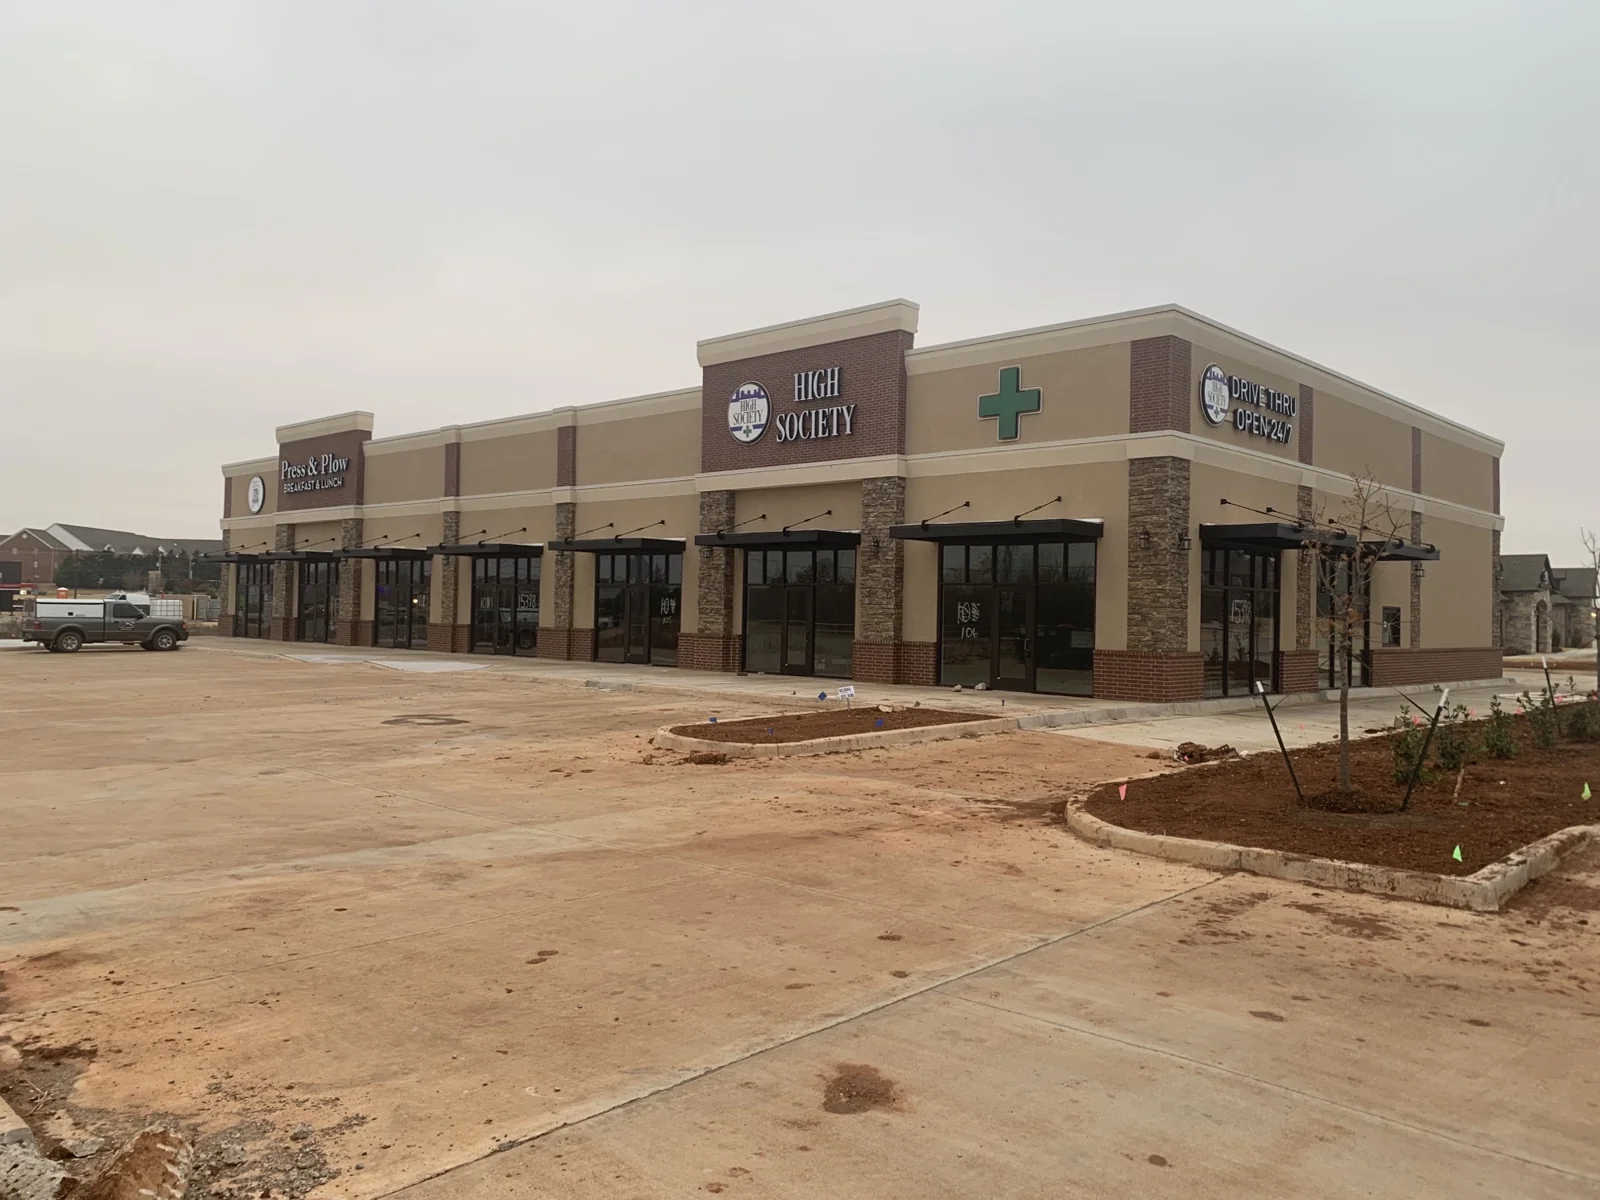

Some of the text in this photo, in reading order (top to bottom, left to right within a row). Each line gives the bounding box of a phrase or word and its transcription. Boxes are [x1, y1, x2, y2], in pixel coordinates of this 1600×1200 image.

[793, 367, 840, 402] HIGH
[1231, 376, 1297, 417] DRIVE THRU
[733, 410, 763, 425] SOCIETY
[740, 398, 757, 411] HIGH
[776, 404, 857, 443] SOCIETY
[1236, 408, 1293, 444] OPEN 24/7
[281, 453, 349, 480] Press & Plow
[284, 477, 343, 494] BREAKFAST & LUNCH
[961, 627, 979, 639] 106
